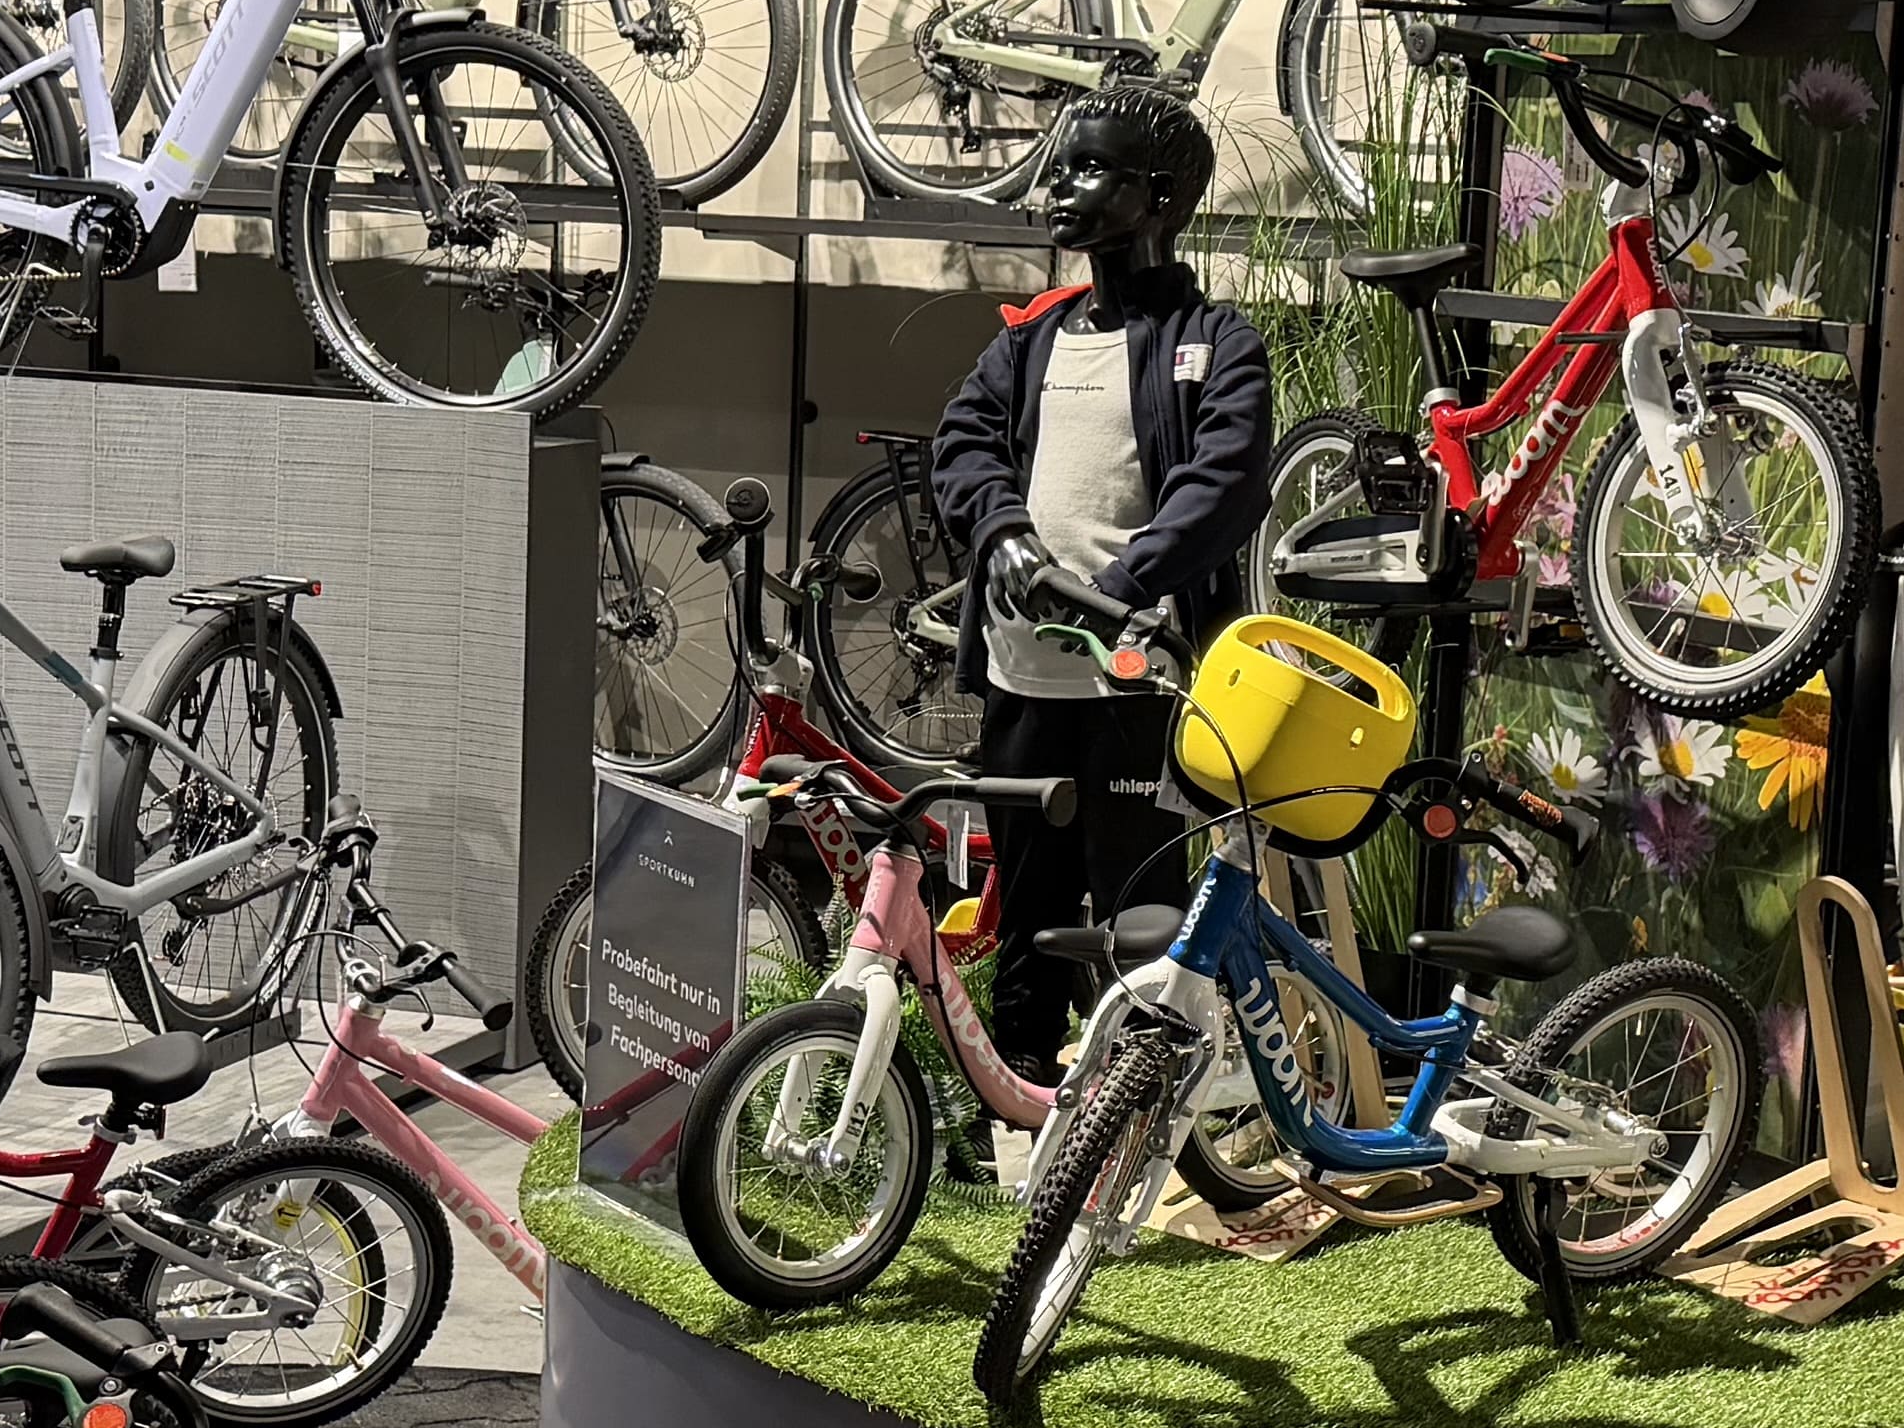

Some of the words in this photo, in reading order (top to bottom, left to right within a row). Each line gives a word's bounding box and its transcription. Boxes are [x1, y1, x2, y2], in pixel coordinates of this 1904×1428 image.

[1043, 382, 1105, 395] Champion
[1481, 400, 1587, 505] woom
[638, 853, 695, 888] SPORTKUHN
[804, 800, 867, 884] woo
[1177, 876, 1216, 942] woom
[601, 939, 677, 995] Probefahrt
[680, 980, 704, 1007] nur
[708, 987, 721, 1016] in
[608, 983, 681, 1043] Begleitung
[684, 1025, 711, 1053] von
[1236, 977, 1313, 1128] woom
[610, 1025, 705, 1088] Fachpersona
